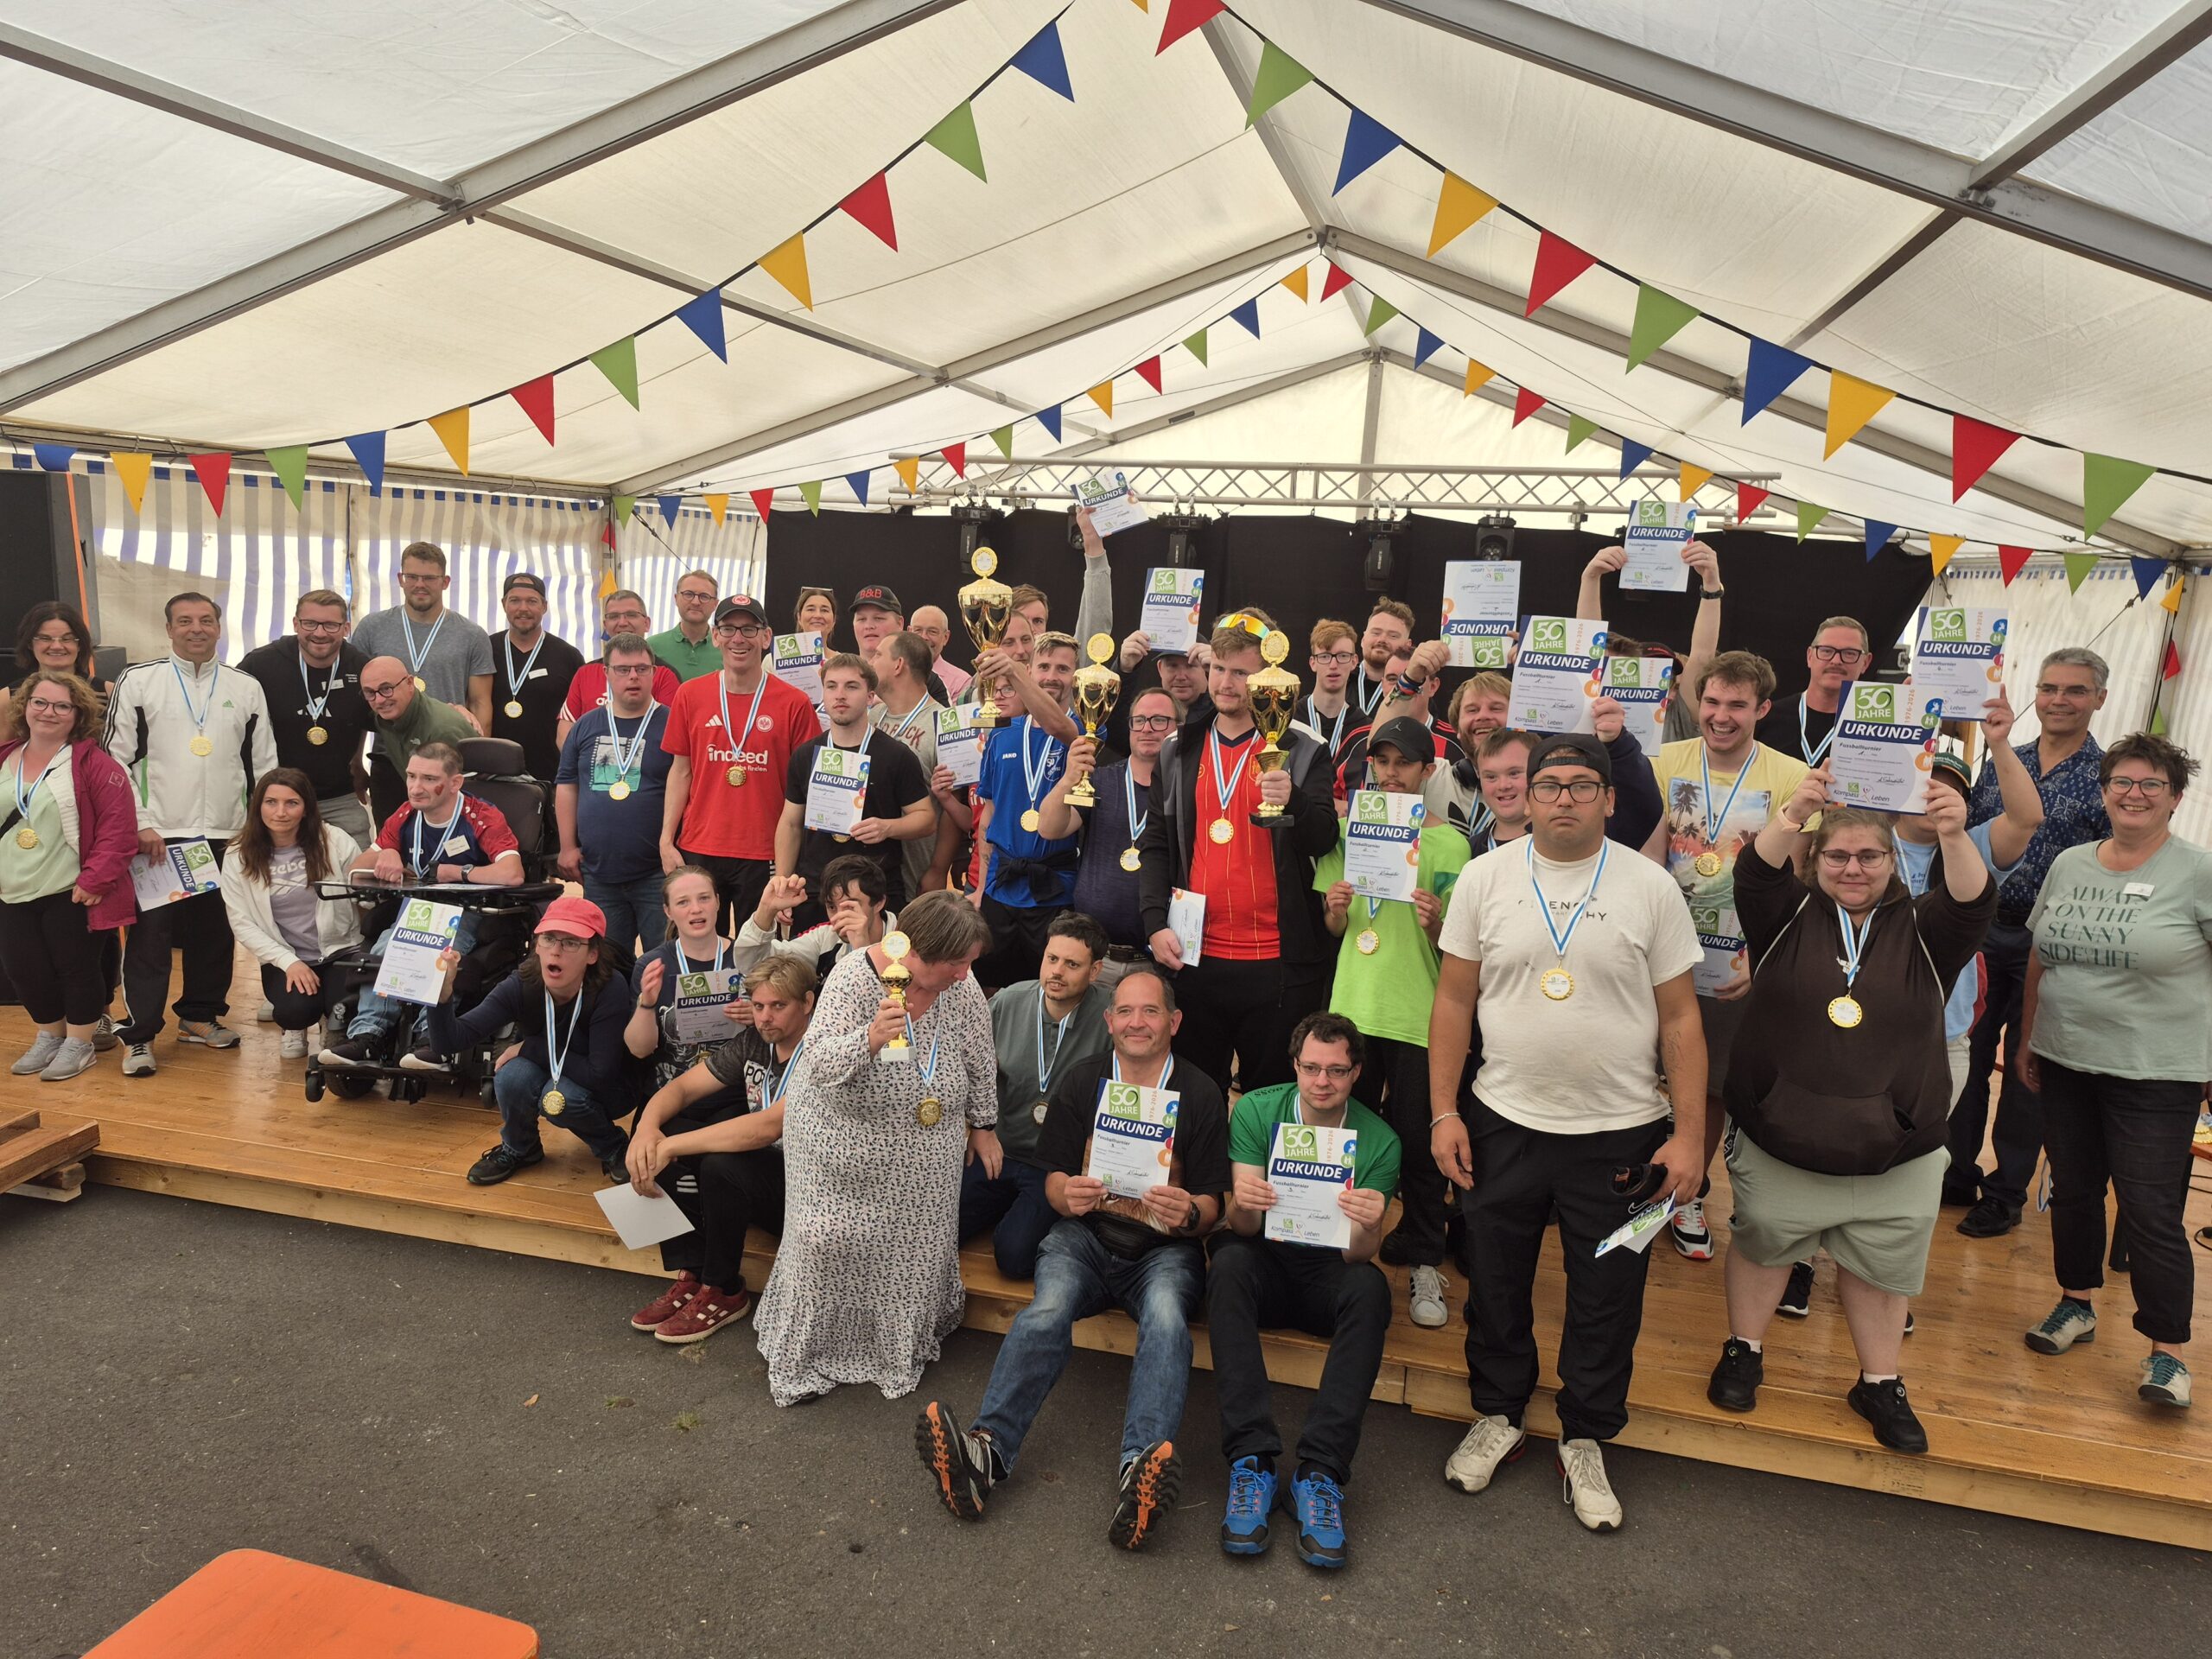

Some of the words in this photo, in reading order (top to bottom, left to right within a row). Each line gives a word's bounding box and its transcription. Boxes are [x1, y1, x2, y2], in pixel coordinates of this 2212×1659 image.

[1082, 480, 1098, 493] 50
[1084, 488, 1124, 505] URKUNDE
[1641, 502, 1664, 518] 50
[1632, 528, 1686, 538] URKUNDE
[1156, 571, 1174, 585] 50
[860, 588, 882, 599] B&B
[1149, 594, 1192, 605] URKUNDE
[1933, 611, 1963, 630] 50
[1450, 624, 1510, 635] URKUNDE
[1535, 621, 1564, 641] 50
[1934, 629, 1963, 639] JAHRE
[779, 637, 796, 652] 50
[1474, 639, 1500, 649] JAHRE
[1535, 640, 1563, 649] JAHRE
[1923, 643, 1992, 656] URKUNDE
[778, 656, 817, 667] URKUNDE
[1475, 647, 1502, 666] 50
[1524, 653, 1591, 669] URKUNDE
[1612, 659, 1638, 677] 50
[1613, 676, 1638, 684] JAHRE
[1605, 688, 1659, 699] URKUNDE
[1857, 688, 1891, 709] 50
[1857, 709, 1891, 719] JAHRE
[1904, 689, 1915, 723] 1976-2026
[941, 709, 957, 726] 50
[940, 729, 976, 743] URKUNDE
[1845, 723, 1923, 741] URKUNDE
[707, 744, 768, 765] indeed
[1839, 742, 1881, 752] Fussballturnier
[823, 752, 842, 765] 50
[816, 773, 858, 788] URKUNDE
[1360, 794, 1385, 812] 50
[1352, 823, 1410, 839] URKUNDE
[192, 846, 211, 864] 50
[173, 849, 194, 888] URKUNDE
[269, 859, 306, 875] eebo
[408, 904, 431, 920] 50
[1694, 908, 1718, 924] 50
[2055, 903, 2090, 919] ON
[2094, 906, 2141, 923] THE
[397, 929, 445, 946] URKUNDE
[2045, 921, 2133, 944] SUNNY
[1698, 934, 1738, 948] KUNDE
[2039, 942, 2084, 963] SIDE
[2094, 948, 2139, 969] LIFE
[683, 975, 705, 990] 50
[686, 987, 708, 996] JAHRE
[681, 994, 731, 1007] URKUNDE
[1110, 1087, 1138, 1106] 50
[1101, 1116, 1164, 1138] URKUNDE
[1286, 1128, 1314, 1147] 50
[1286, 1147, 1314, 1157] JAHRE
[1276, 1160, 1343, 1179] URKUNDE
